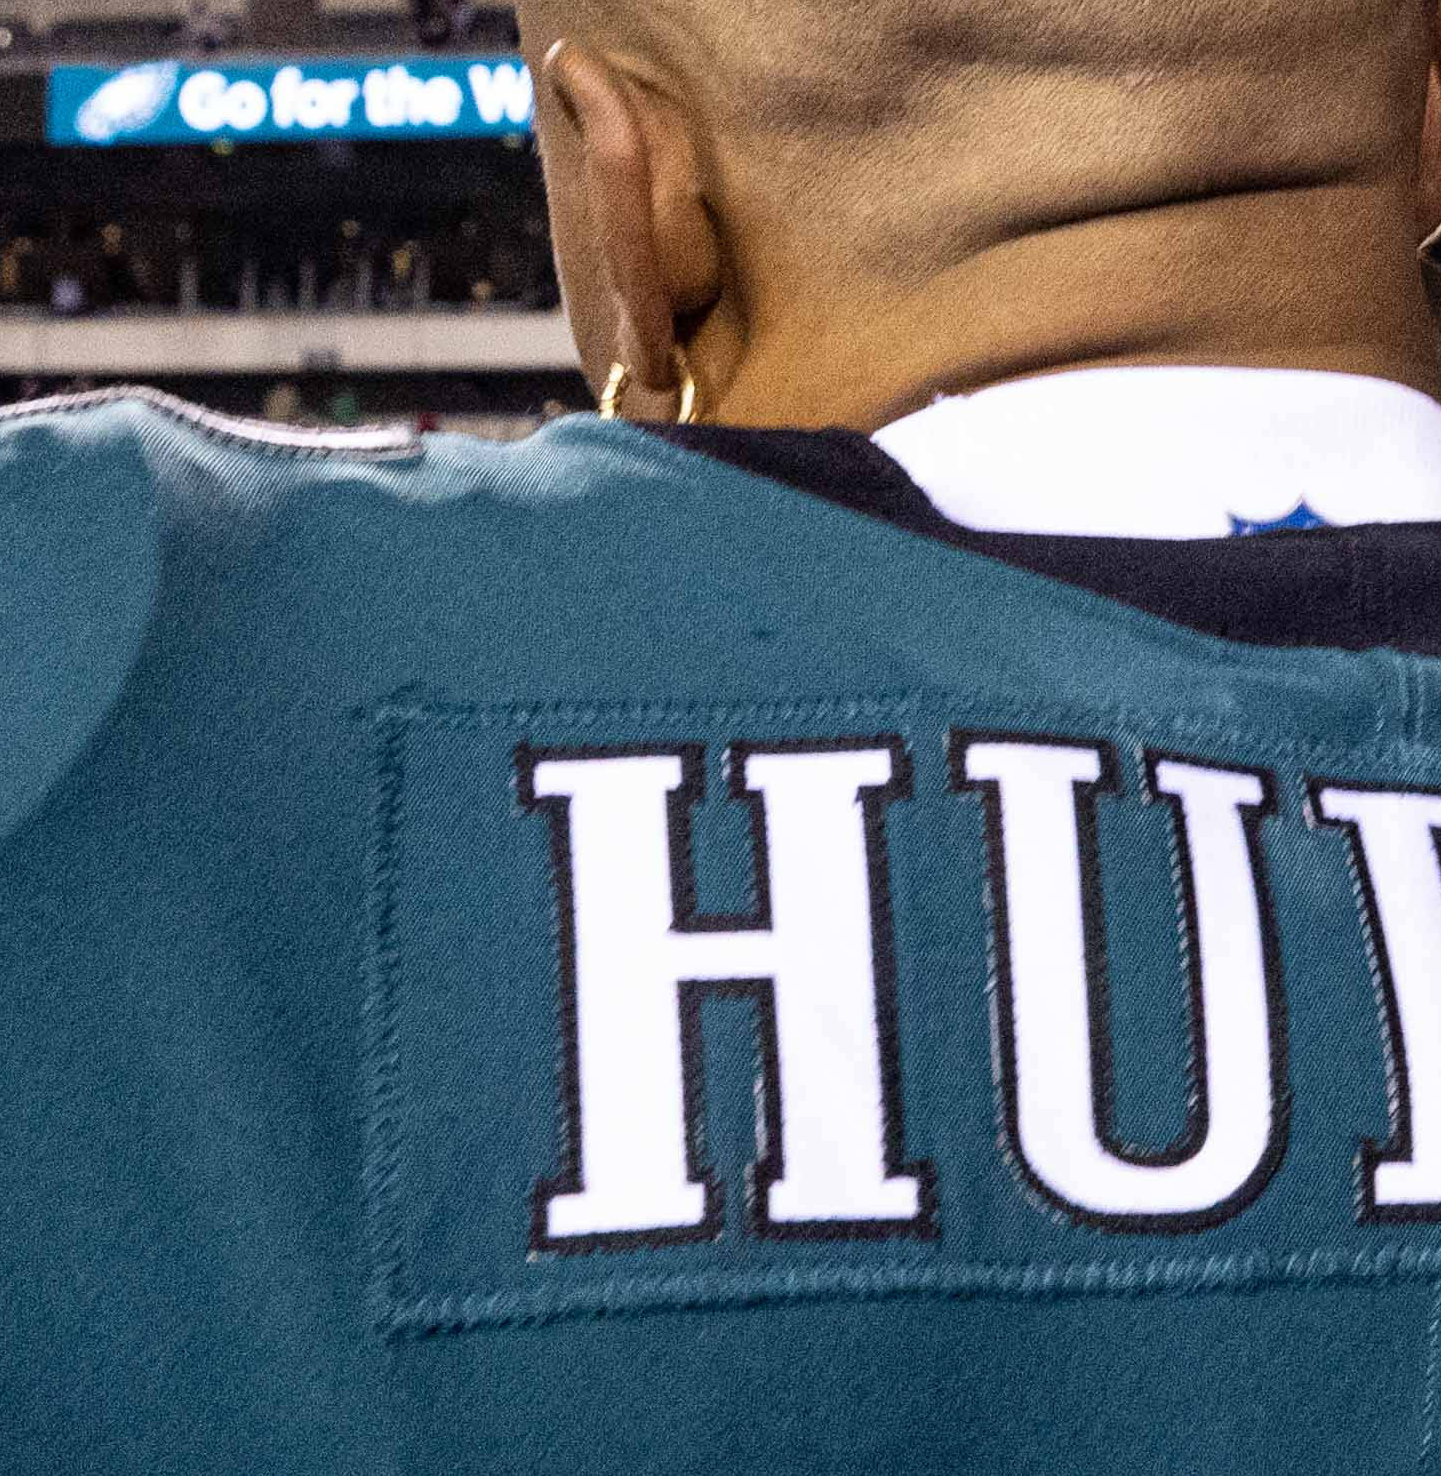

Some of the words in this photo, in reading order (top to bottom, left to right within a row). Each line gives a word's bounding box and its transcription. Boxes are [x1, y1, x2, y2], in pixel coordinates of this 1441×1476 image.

[179, 71, 267, 131] Go
[271, 66, 357, 129] for
[363, 65, 462, 126] the
